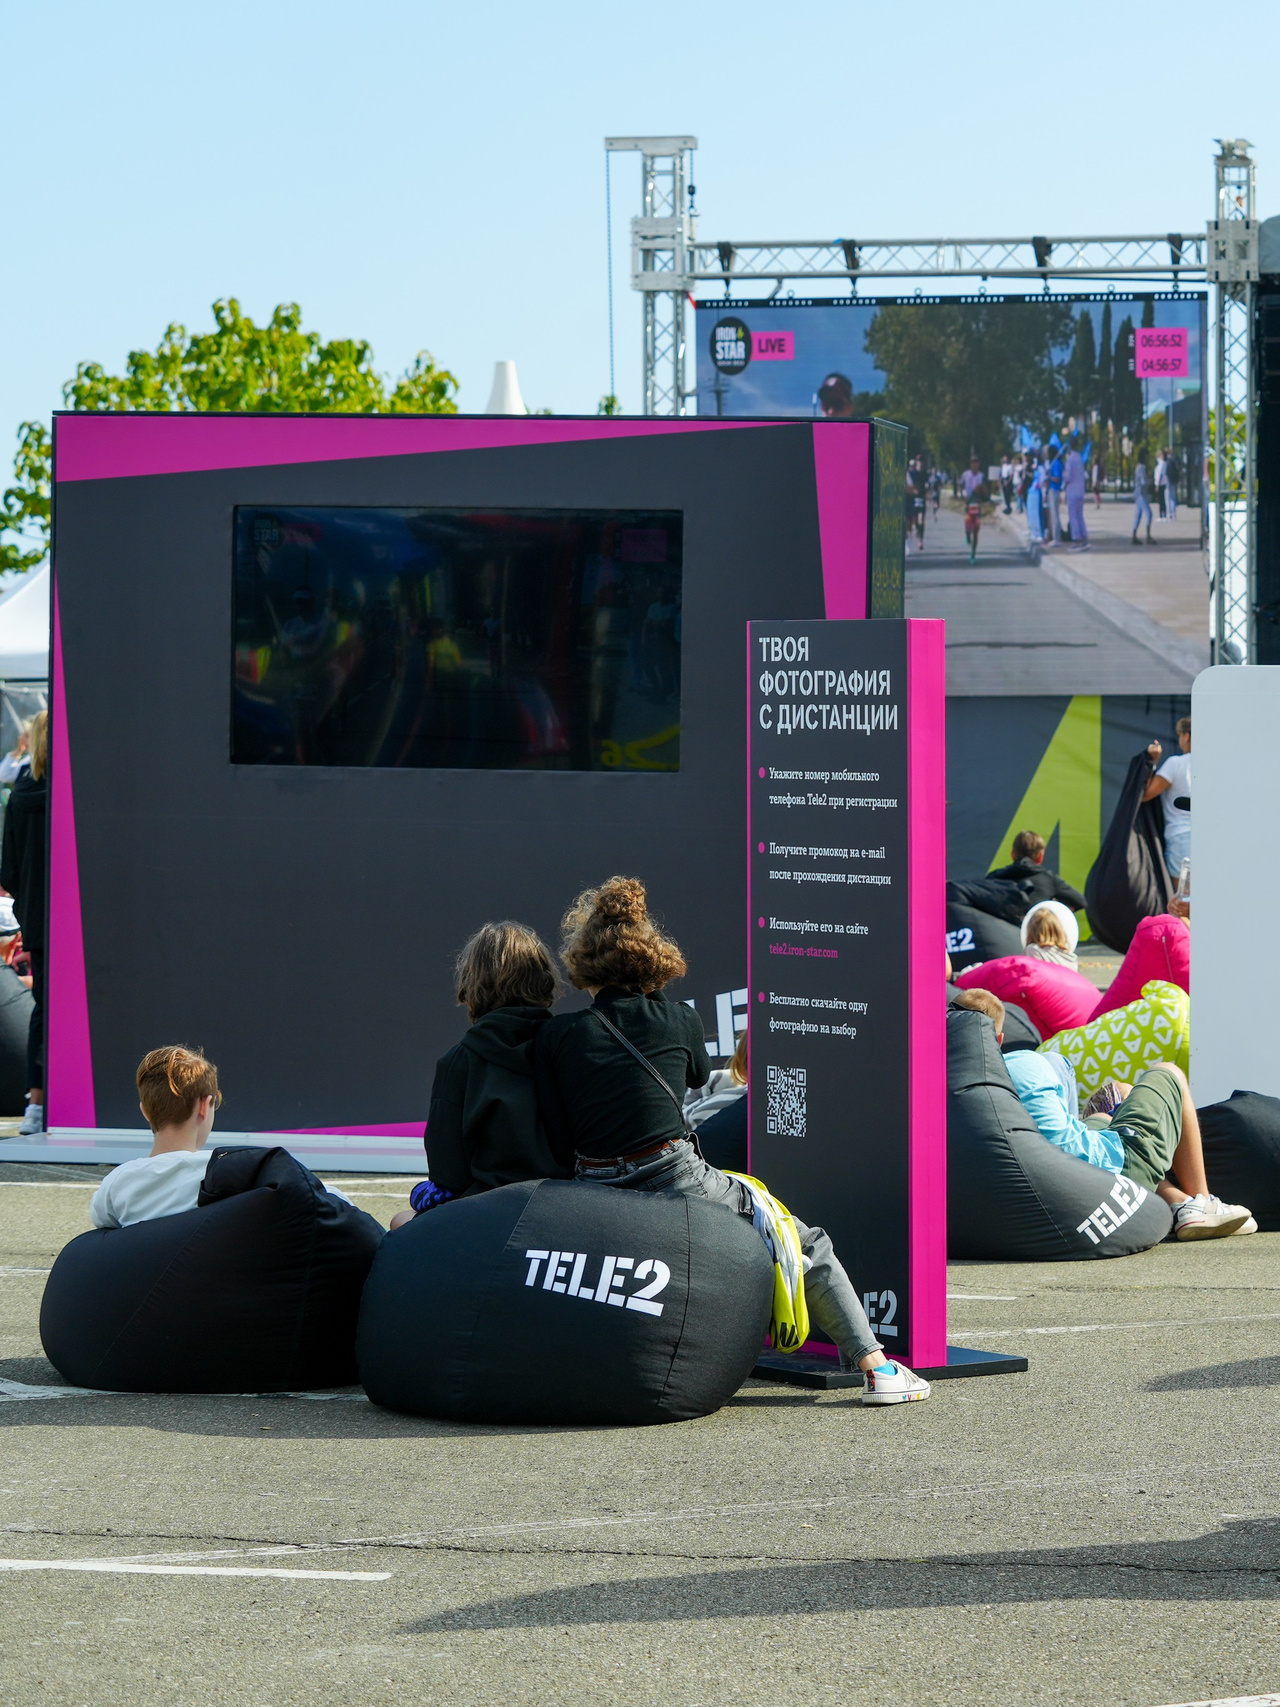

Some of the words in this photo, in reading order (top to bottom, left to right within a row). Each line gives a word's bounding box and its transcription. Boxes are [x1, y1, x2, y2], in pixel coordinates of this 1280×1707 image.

[715, 341, 746, 360] STAR
[758, 338, 786, 353] LIVE
[758, 636, 809, 662] ТВОЯ
[759, 670, 891, 696] ФОТОГРАФИЯ
[759, 704, 773, 730] С
[777, 704, 898, 736] ДИСТАНЦИИ
[769, 767, 803, 780] Укажите
[804, 770, 830, 783] номер
[831, 768, 880, 782] мобильного
[769, 793, 806, 808] телефона
[807, 794, 827, 806] Tele2
[828, 797, 844, 810] при
[846, 797, 898, 810] регистрации
[769, 842, 807, 858] Получите
[808, 846, 849, 860] промокод
[850, 849, 860, 858] на
[861, 847, 886, 859] e-mail
[769, 870, 791, 880] после
[793, 871, 846, 884] прохождения
[847, 874, 891, 886] дистанции
[769, 917, 819, 935] Используйте
[820, 922, 833, 934] его
[834, 924, 845, 933] на
[846, 923, 869, 935] сайте
[769, 943, 838, 958] tele2.iron-star.com
[769, 992, 810, 1007] Бесплатно
[811, 998, 847, 1010] скачайте
[848, 1001, 868, 1015] одну
[769, 1017, 819, 1035] фотографию
[820, 1024, 830, 1034] на
[831, 1023, 857, 1039] выбор
[1076, 1173, 1148, 1245] TELE2
[524, 1249, 671, 1317] TELE2
